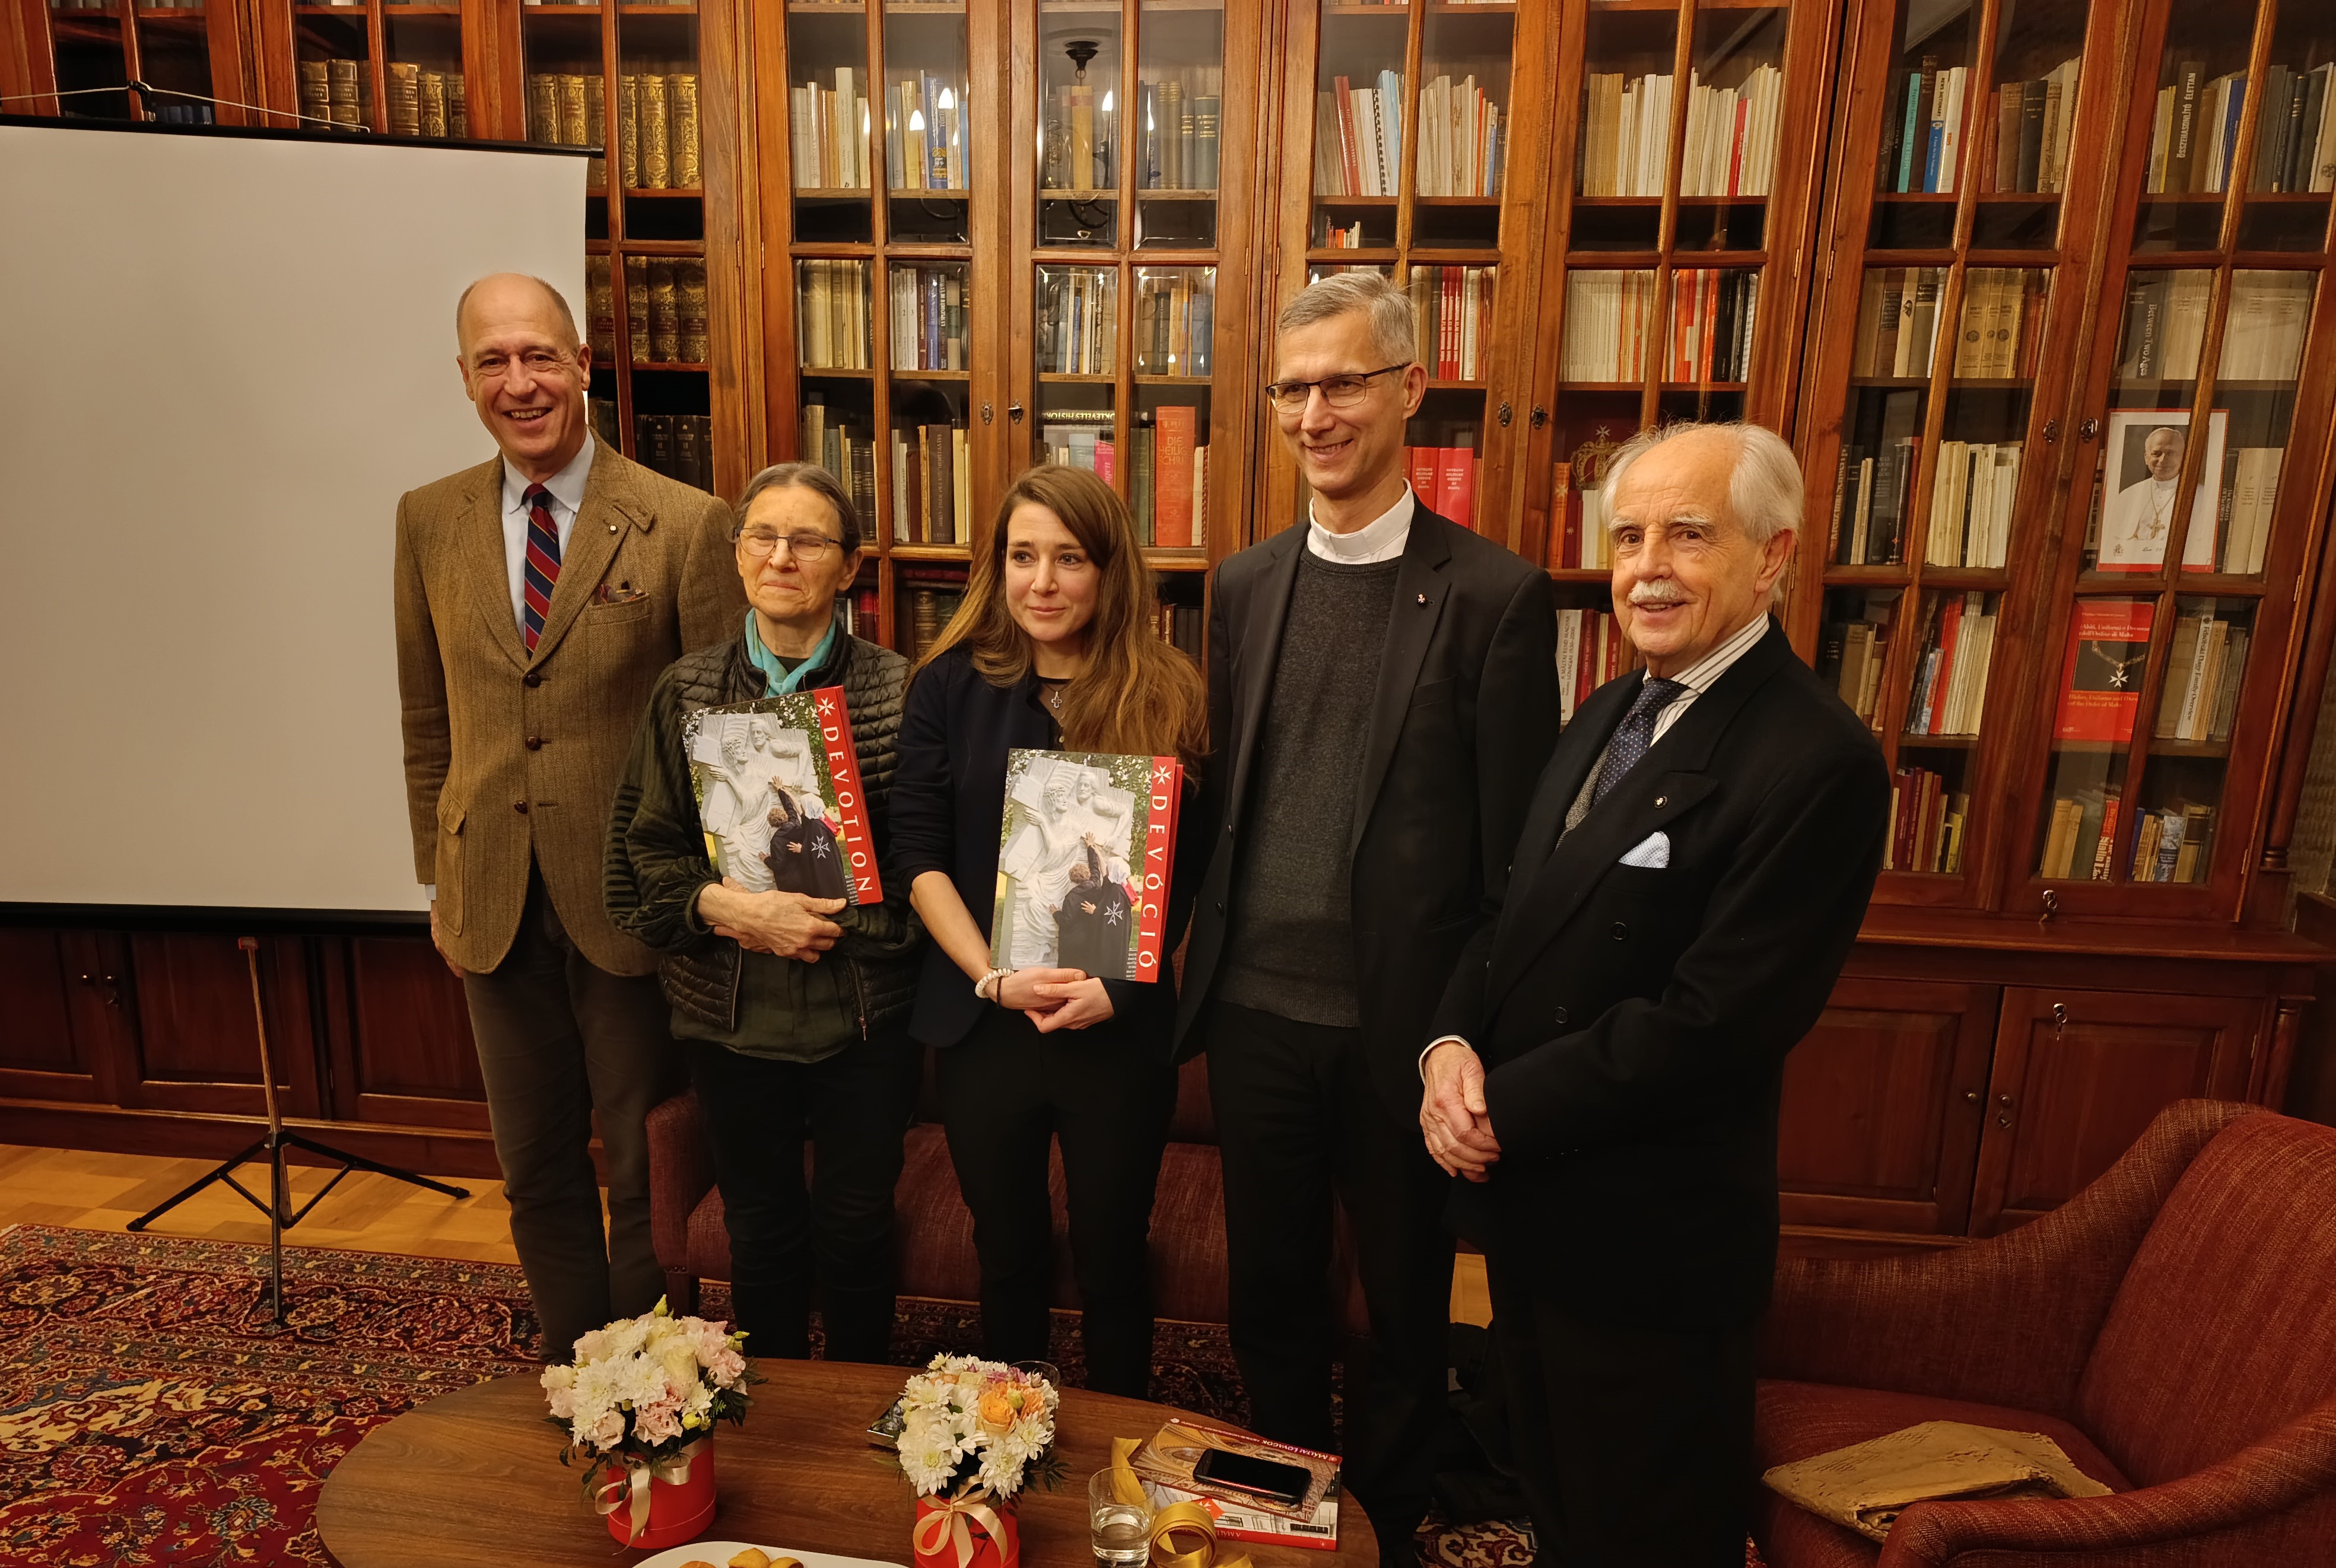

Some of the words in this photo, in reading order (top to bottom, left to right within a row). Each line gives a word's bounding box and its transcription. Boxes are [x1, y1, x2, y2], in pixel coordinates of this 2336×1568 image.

[2176, 103, 2192, 158] ÖSSZEHASONLÍTÓ
[2184, 72, 2196, 100] ÉLETTAN
[2144, 303, 2158, 338] Between
[2143, 337, 2153, 356] Two
[2140, 356, 2151, 377] Ages
[1158, 446, 1193, 456] HEILIGE
[1167, 436, 1184, 446] DIE
[2195, 655, 2204, 671] Nagy
[2191, 672, 2202, 692] Family
[2187, 692, 2197, 721] Overview
[823, 726, 873, 891] DEVOTION
[1138, 795, 1168, 968] DEVÓCIÓ
[1261, 1439, 1298, 1453] LOVAGOK
[1299, 1448, 1328, 1461] MÁLTAI
